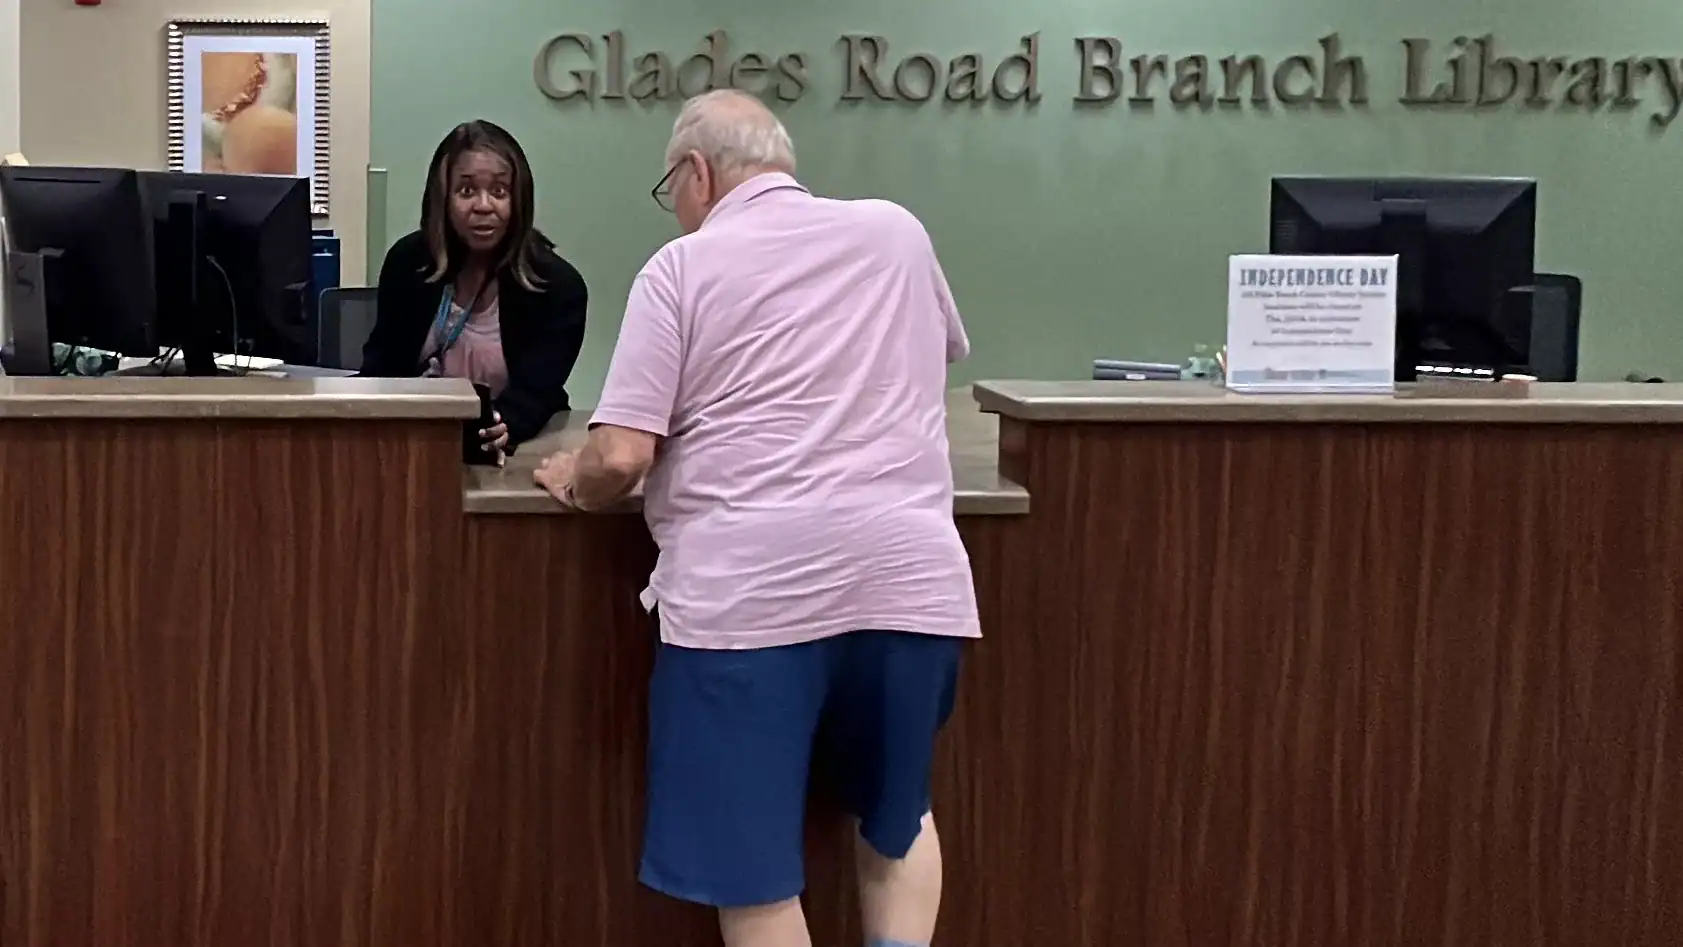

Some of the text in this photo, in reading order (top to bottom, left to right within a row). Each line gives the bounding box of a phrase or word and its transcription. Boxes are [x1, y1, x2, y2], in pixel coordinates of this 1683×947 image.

[533, 29, 1683, 126] Glades Road Branch Library
[1240, 268, 1388, 286] INDEPENDENCE DAY
